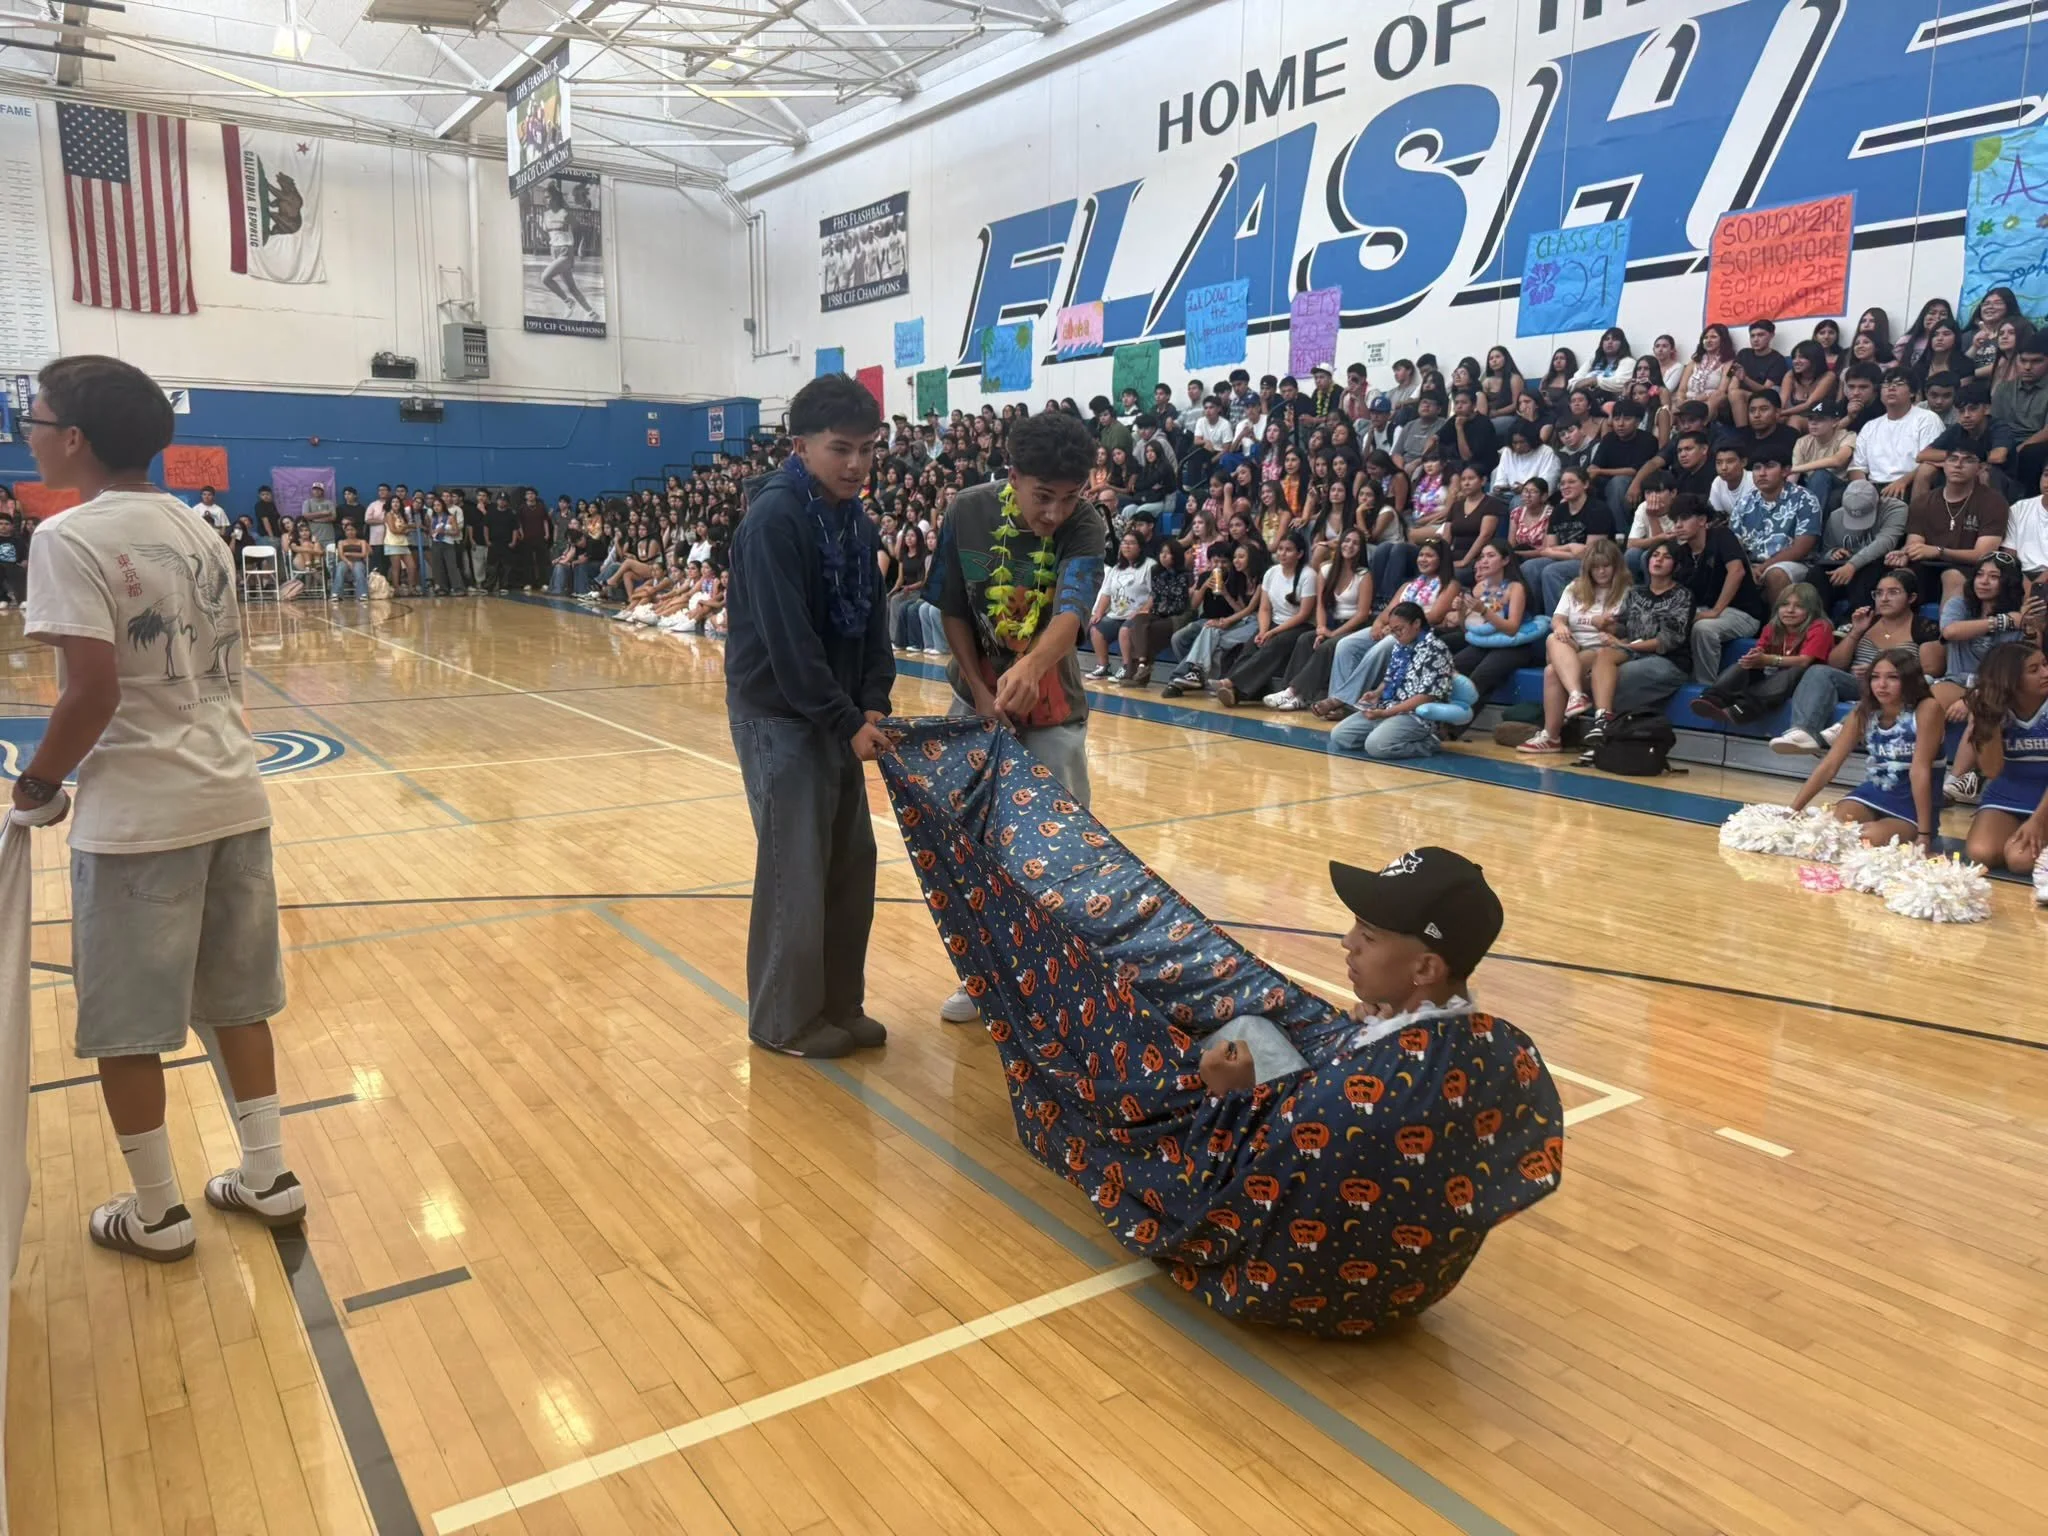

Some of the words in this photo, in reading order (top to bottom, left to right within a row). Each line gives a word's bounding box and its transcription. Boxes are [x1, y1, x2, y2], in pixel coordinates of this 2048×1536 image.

[516, 84, 528, 101] FHS
[1158, 37, 1348, 152] HOME
[1374, 0, 1486, 81] OF
[0, 103, 32, 117] FAME
[243, 150, 257, 203] CALIFORNIA
[247, 205, 259, 248] REPUBLIC
[833, 216, 848, 231] FHS
[849, 202, 891, 226] FLASHBACK
[1722, 200, 1847, 246] SOPHOM2RE
[1536, 230, 1588, 259] CLASS
[1595, 223, 1626, 251] OF
[843, 289, 855, 304] CIF
[856, 280, 901, 301] CHAMPIONS
[1719, 263, 1844, 297] SOPHOM2RE
[526, 320, 542, 329] 1991
[543, 322, 557, 330] CIF
[559, 324, 604, 334] CHAMPIONS
[116, 553, 143, 598] 東京都
